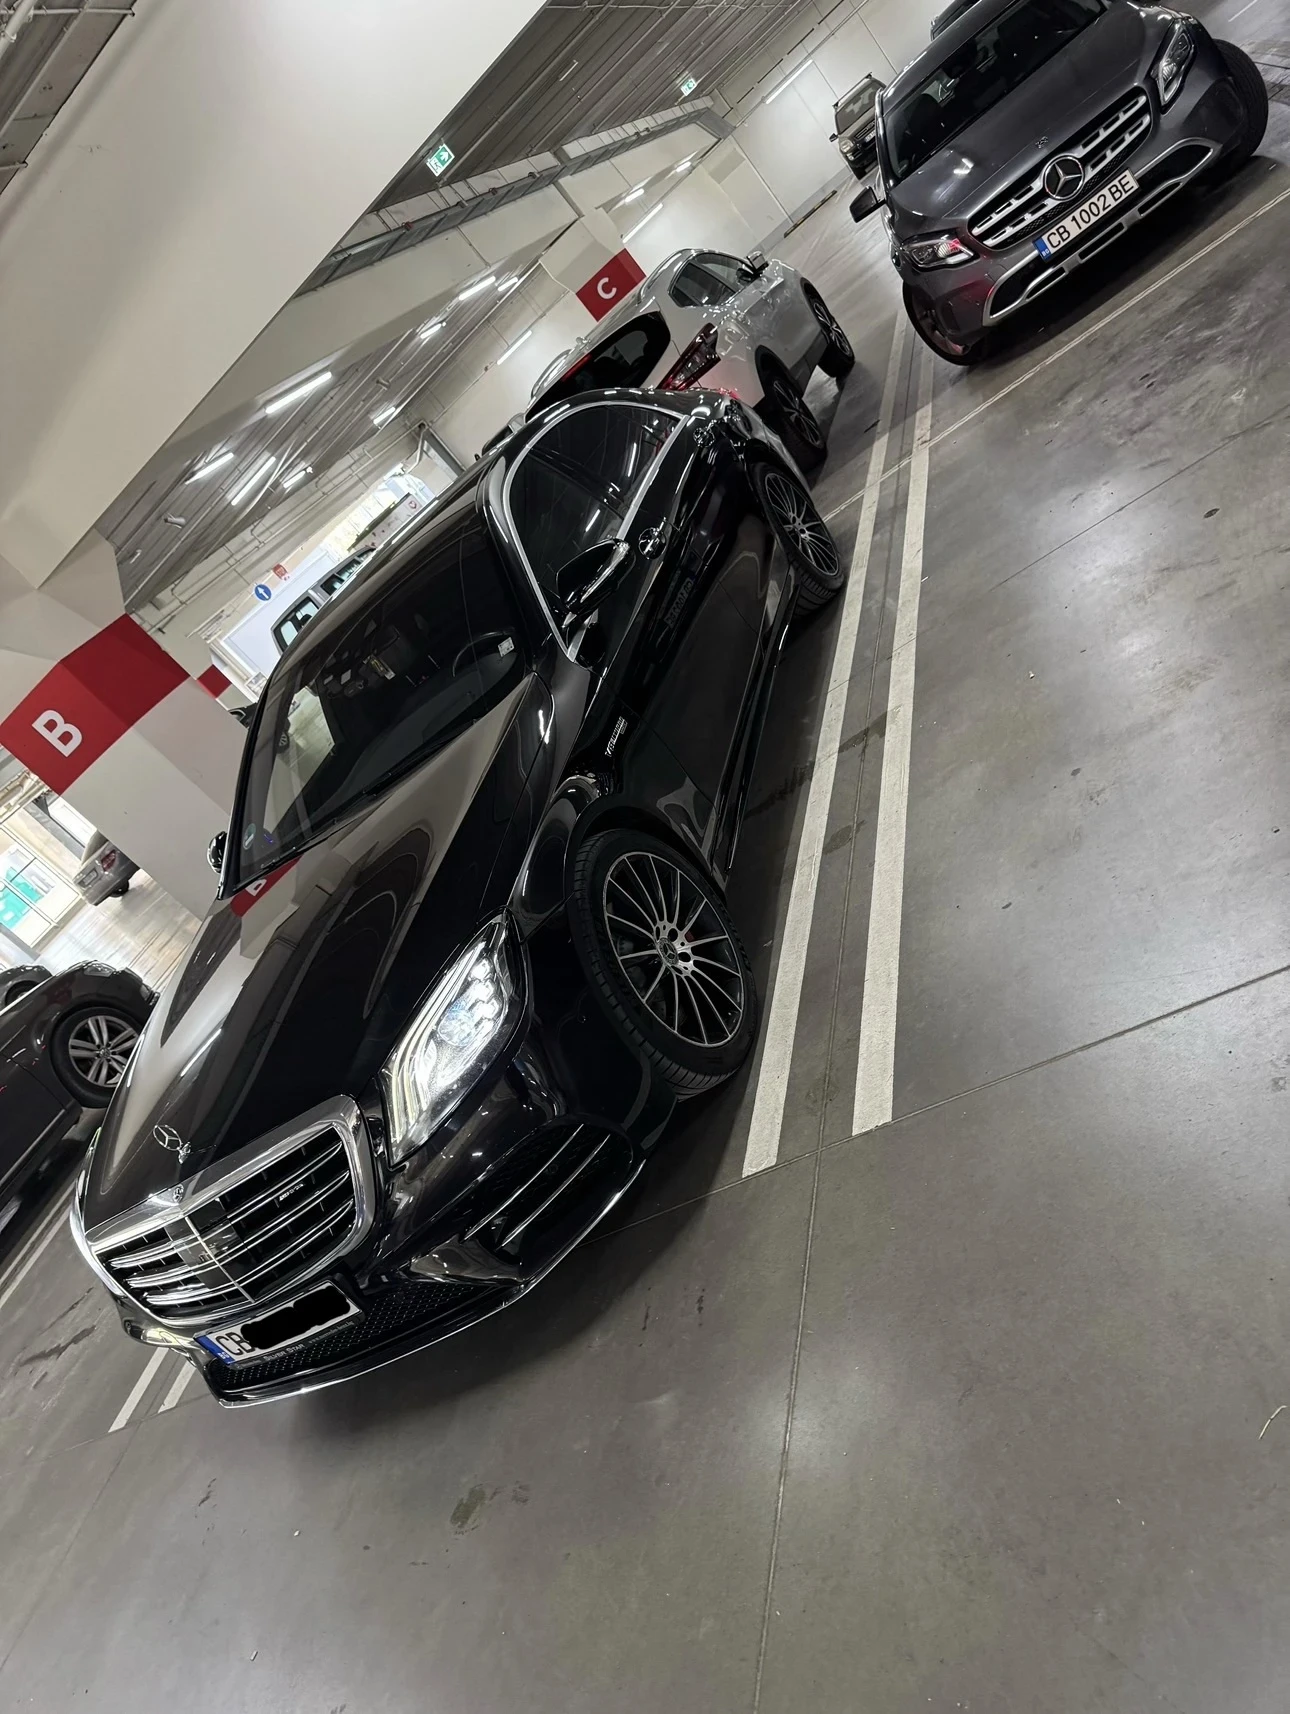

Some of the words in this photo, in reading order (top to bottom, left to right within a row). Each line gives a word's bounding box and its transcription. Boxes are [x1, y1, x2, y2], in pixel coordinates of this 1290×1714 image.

[1047, 225, 1071, 249] CB
[1071, 194, 1112, 230] 1002
[1108, 174, 1134, 202] BE
[597, 276, 617, 300] C
[31, 709, 83, 758] B
[215, 1332, 256, 1356] CB
